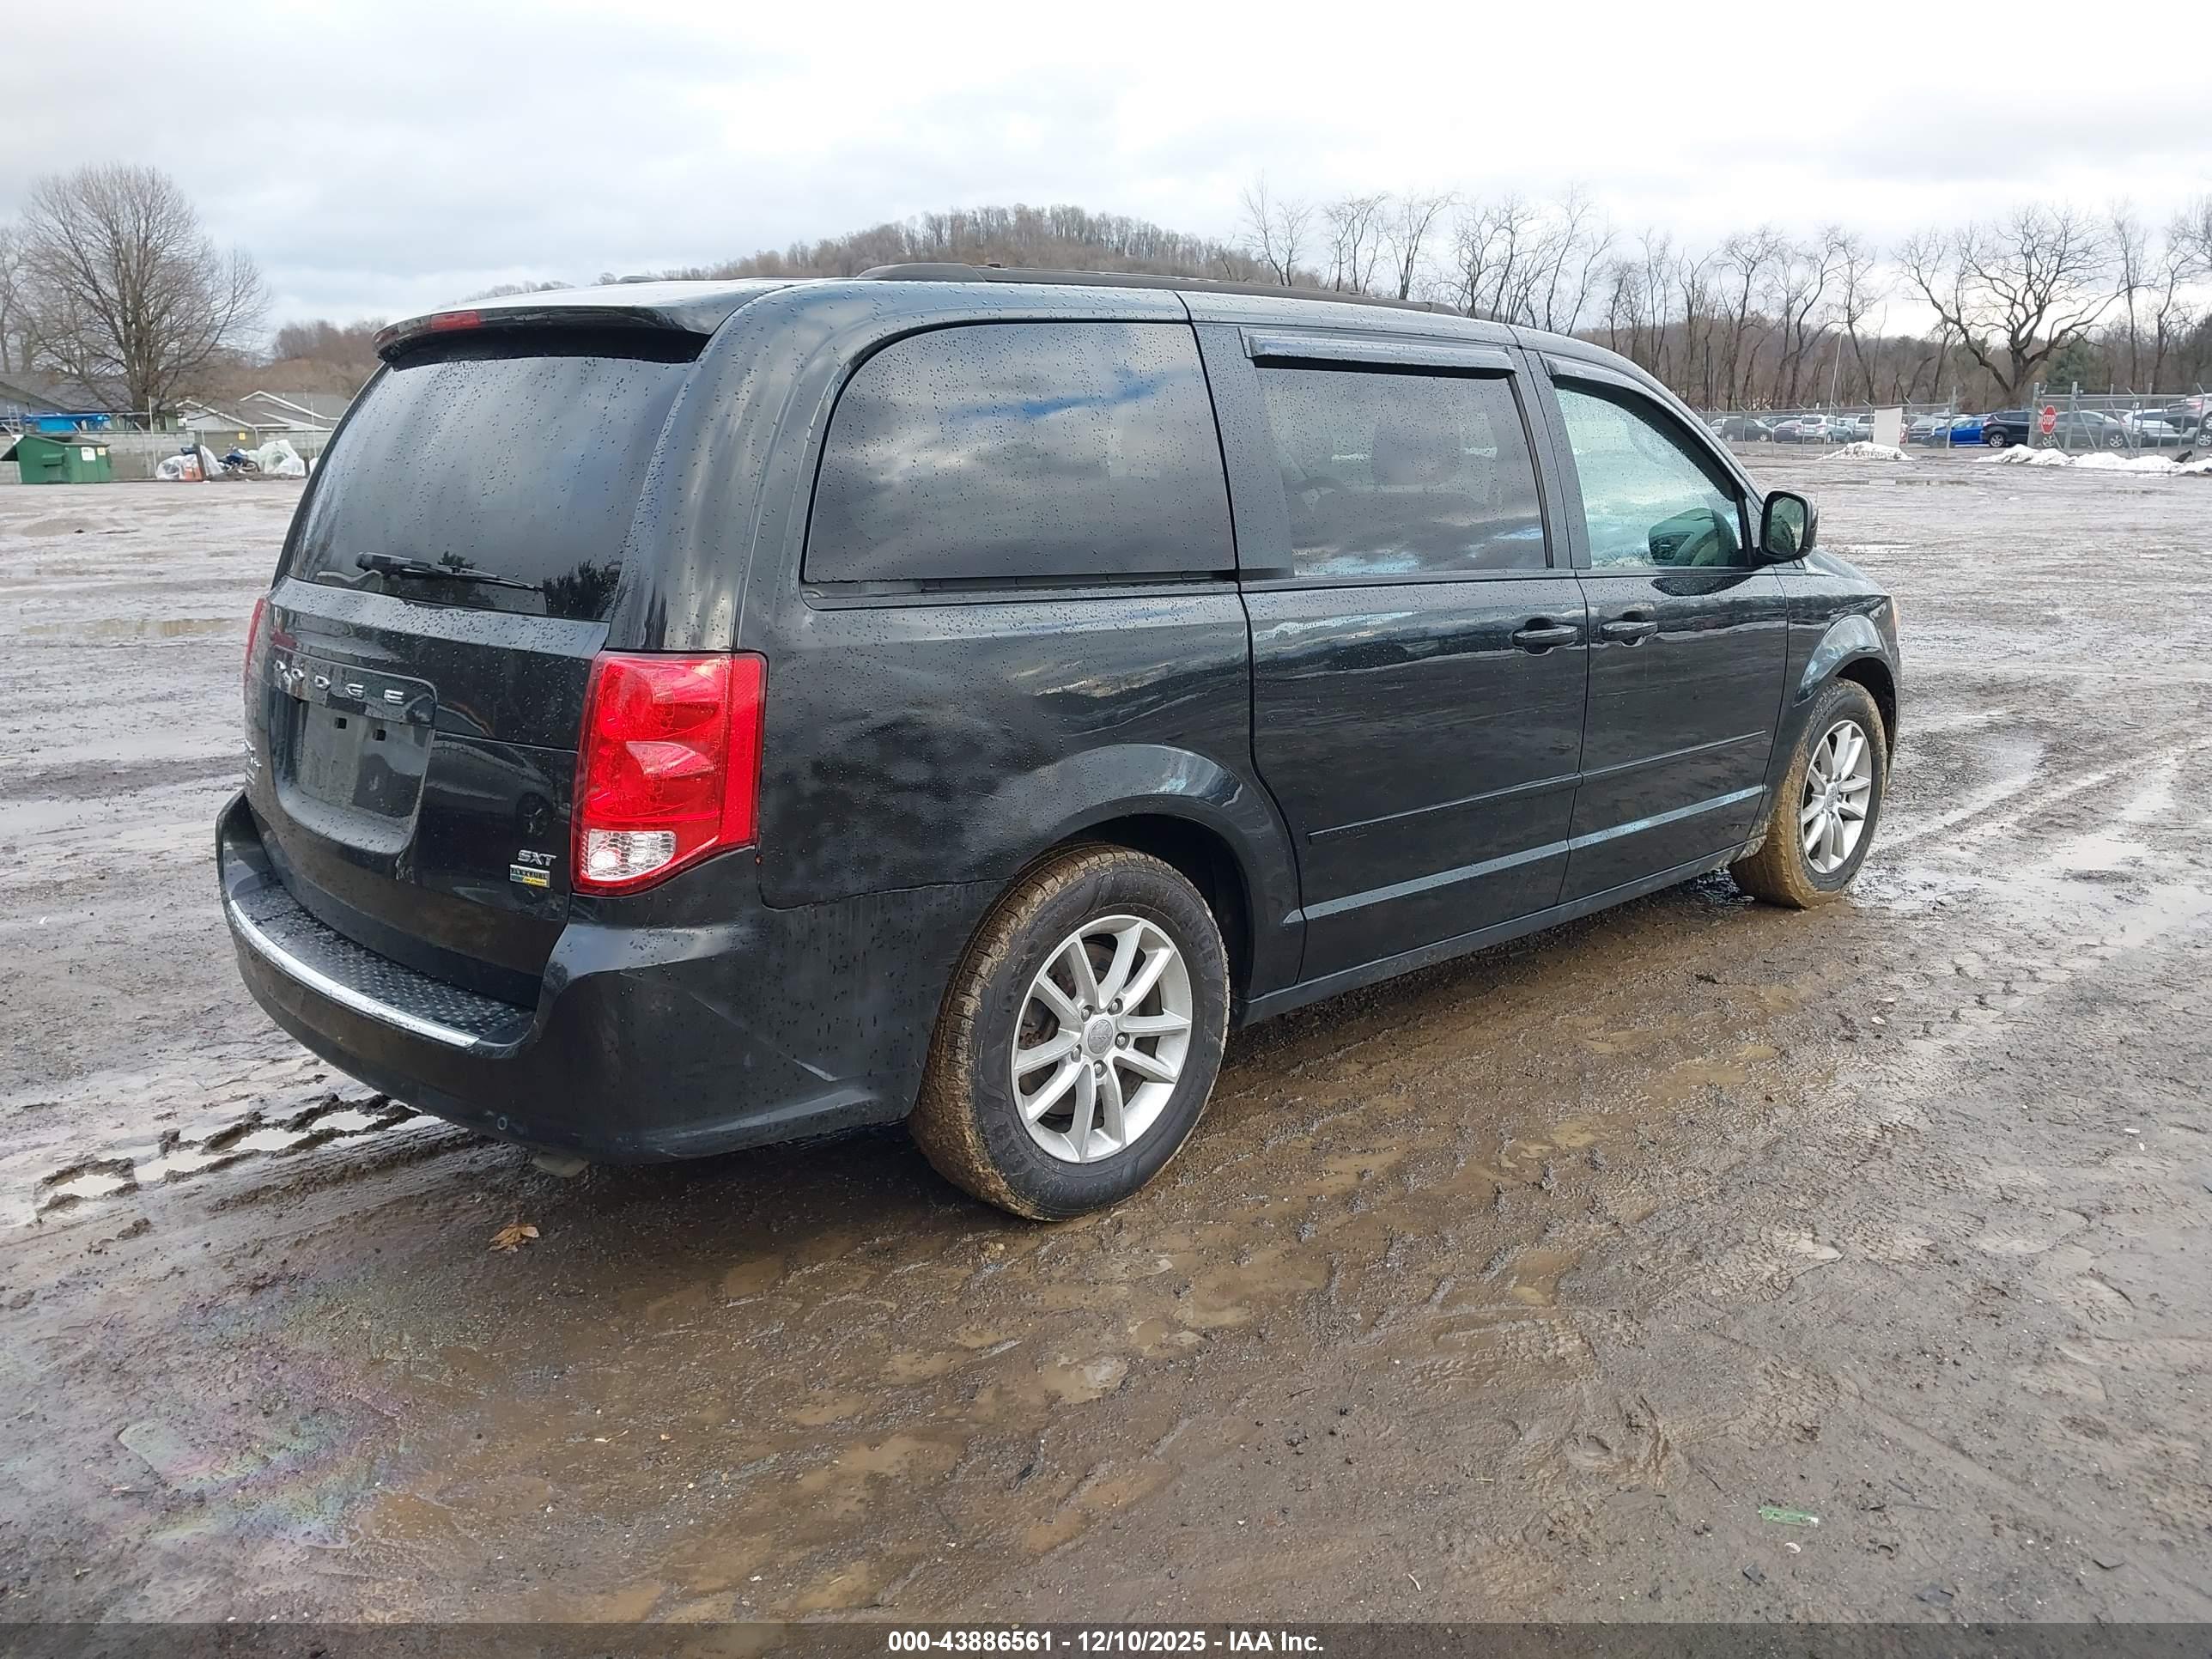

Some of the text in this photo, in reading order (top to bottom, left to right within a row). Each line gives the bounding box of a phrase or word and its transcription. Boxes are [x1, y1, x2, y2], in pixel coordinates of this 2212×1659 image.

[2042, 414, 2056, 426] STOP
[274, 659, 405, 705] DODGE
[517, 849, 557, 866] SXT
